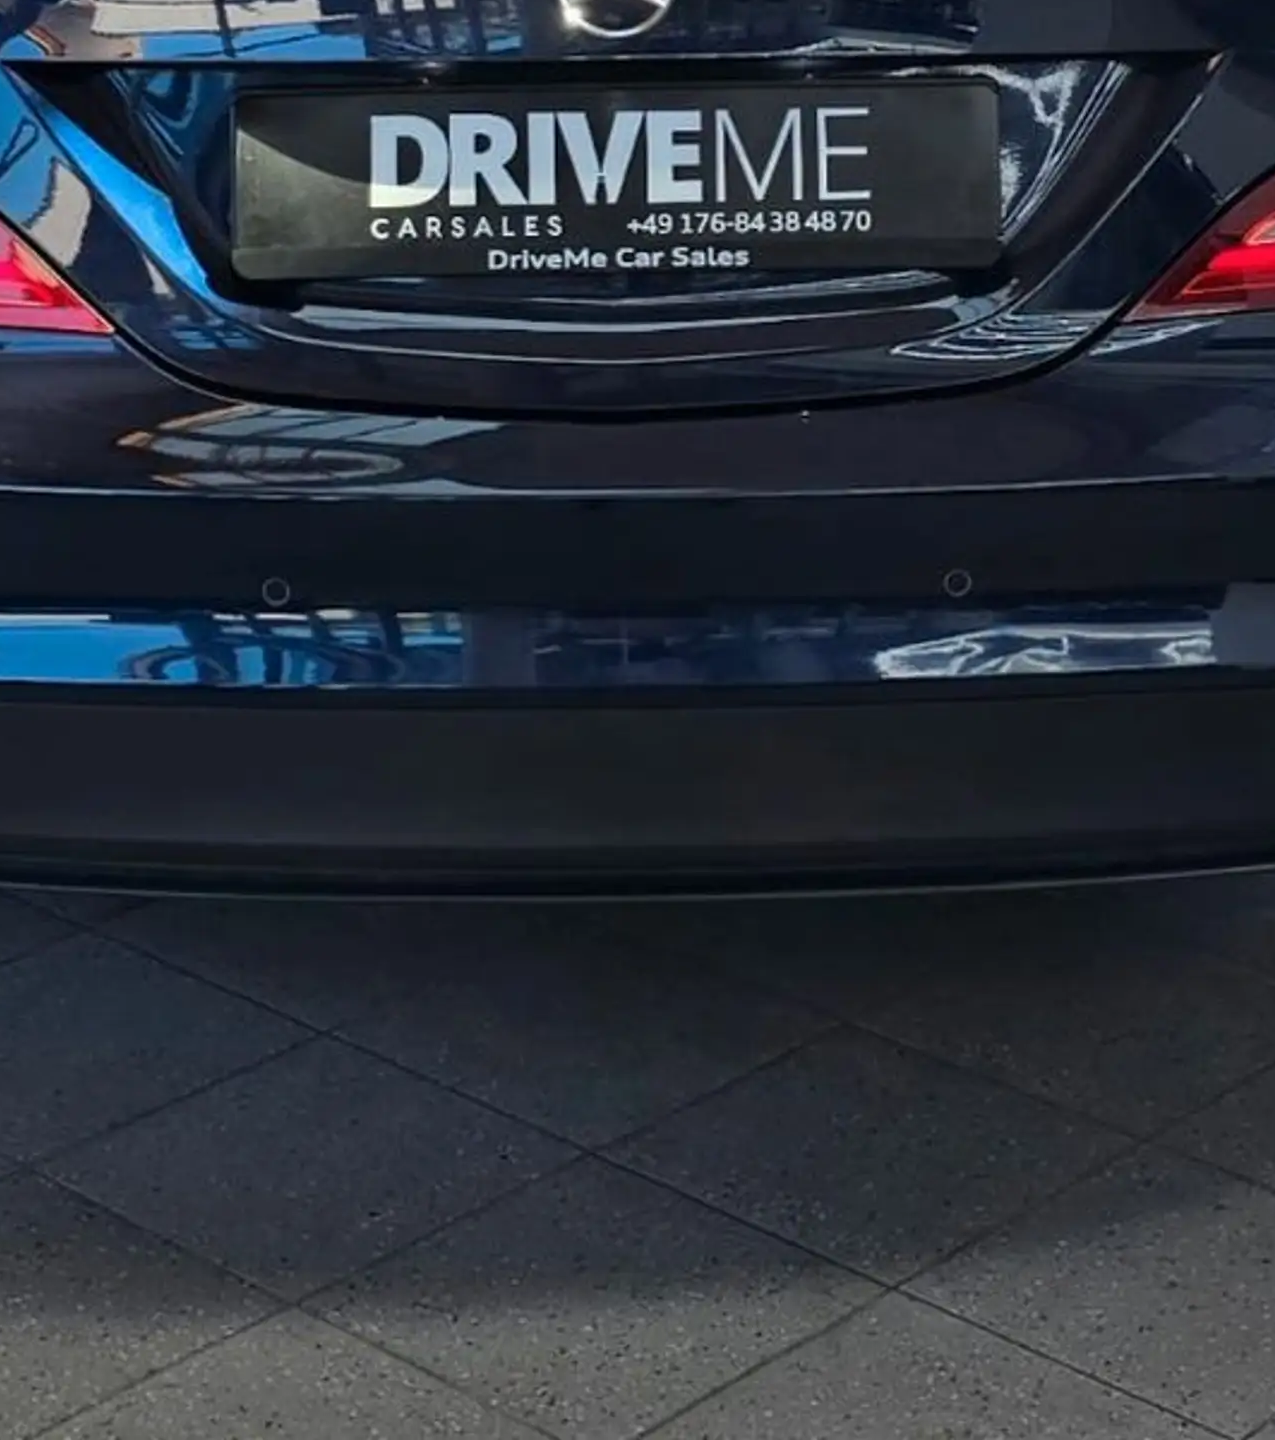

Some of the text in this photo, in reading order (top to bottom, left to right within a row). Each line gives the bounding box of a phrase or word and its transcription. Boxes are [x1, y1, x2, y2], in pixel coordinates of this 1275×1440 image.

[369, 105, 872, 208] DRIVEME
[369, 215, 564, 240] CARSALES
[626, 213, 673, 235] +49
[487, 246, 751, 270] DriveMe Car Sales
